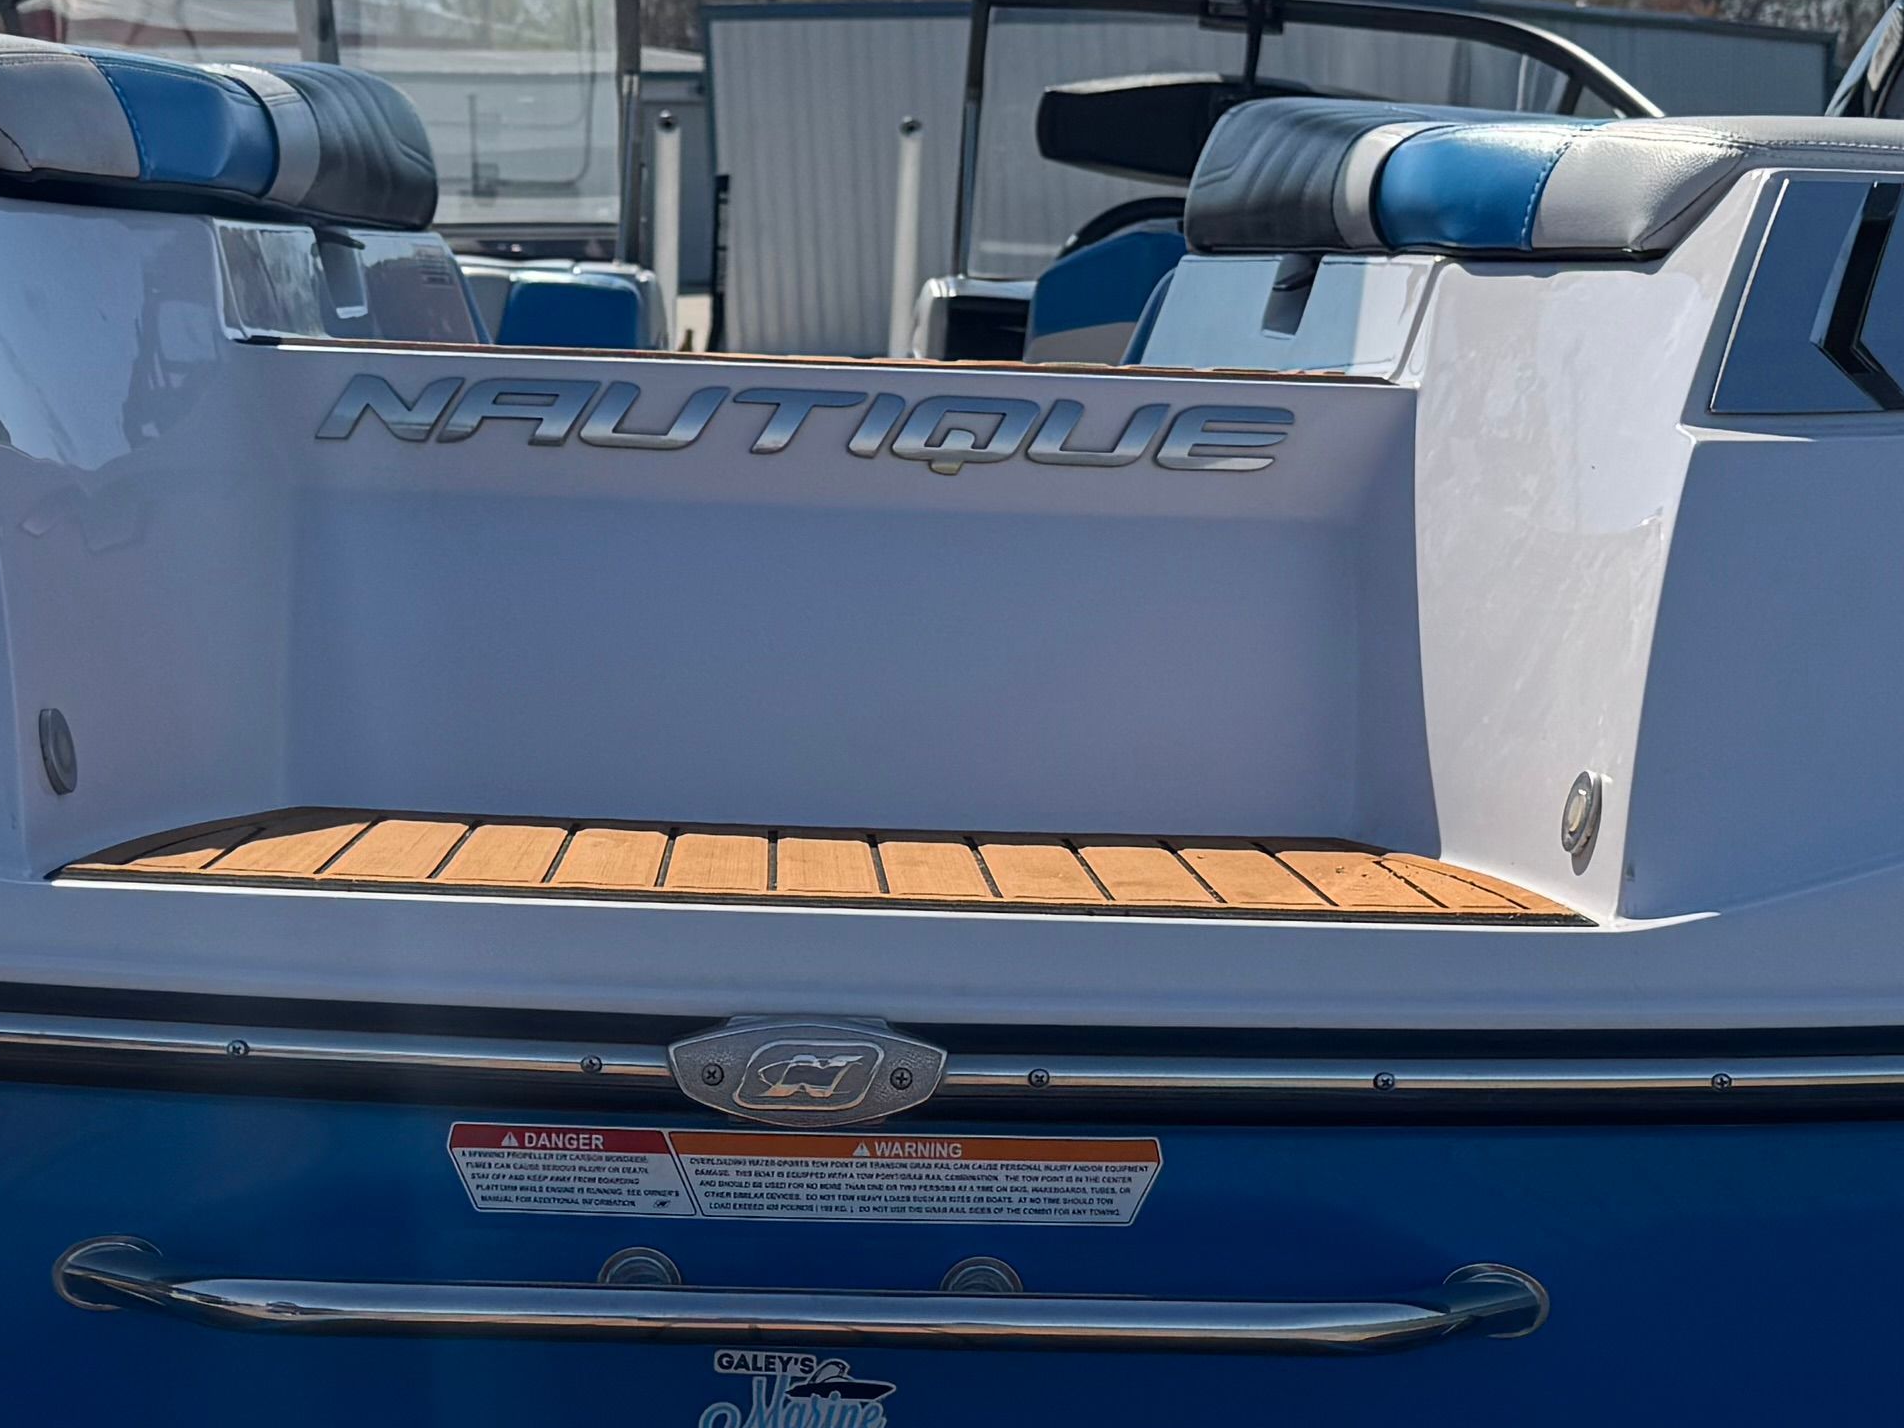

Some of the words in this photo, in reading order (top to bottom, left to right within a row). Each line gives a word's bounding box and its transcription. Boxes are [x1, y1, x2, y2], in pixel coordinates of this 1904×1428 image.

[315, 372, 1295, 475] NAUTIQUE
[524, 1131, 604, 1150] DANGER
[875, 1141, 962, 1158] WARNING
[717, 1352, 815, 1374] GALEY'S
